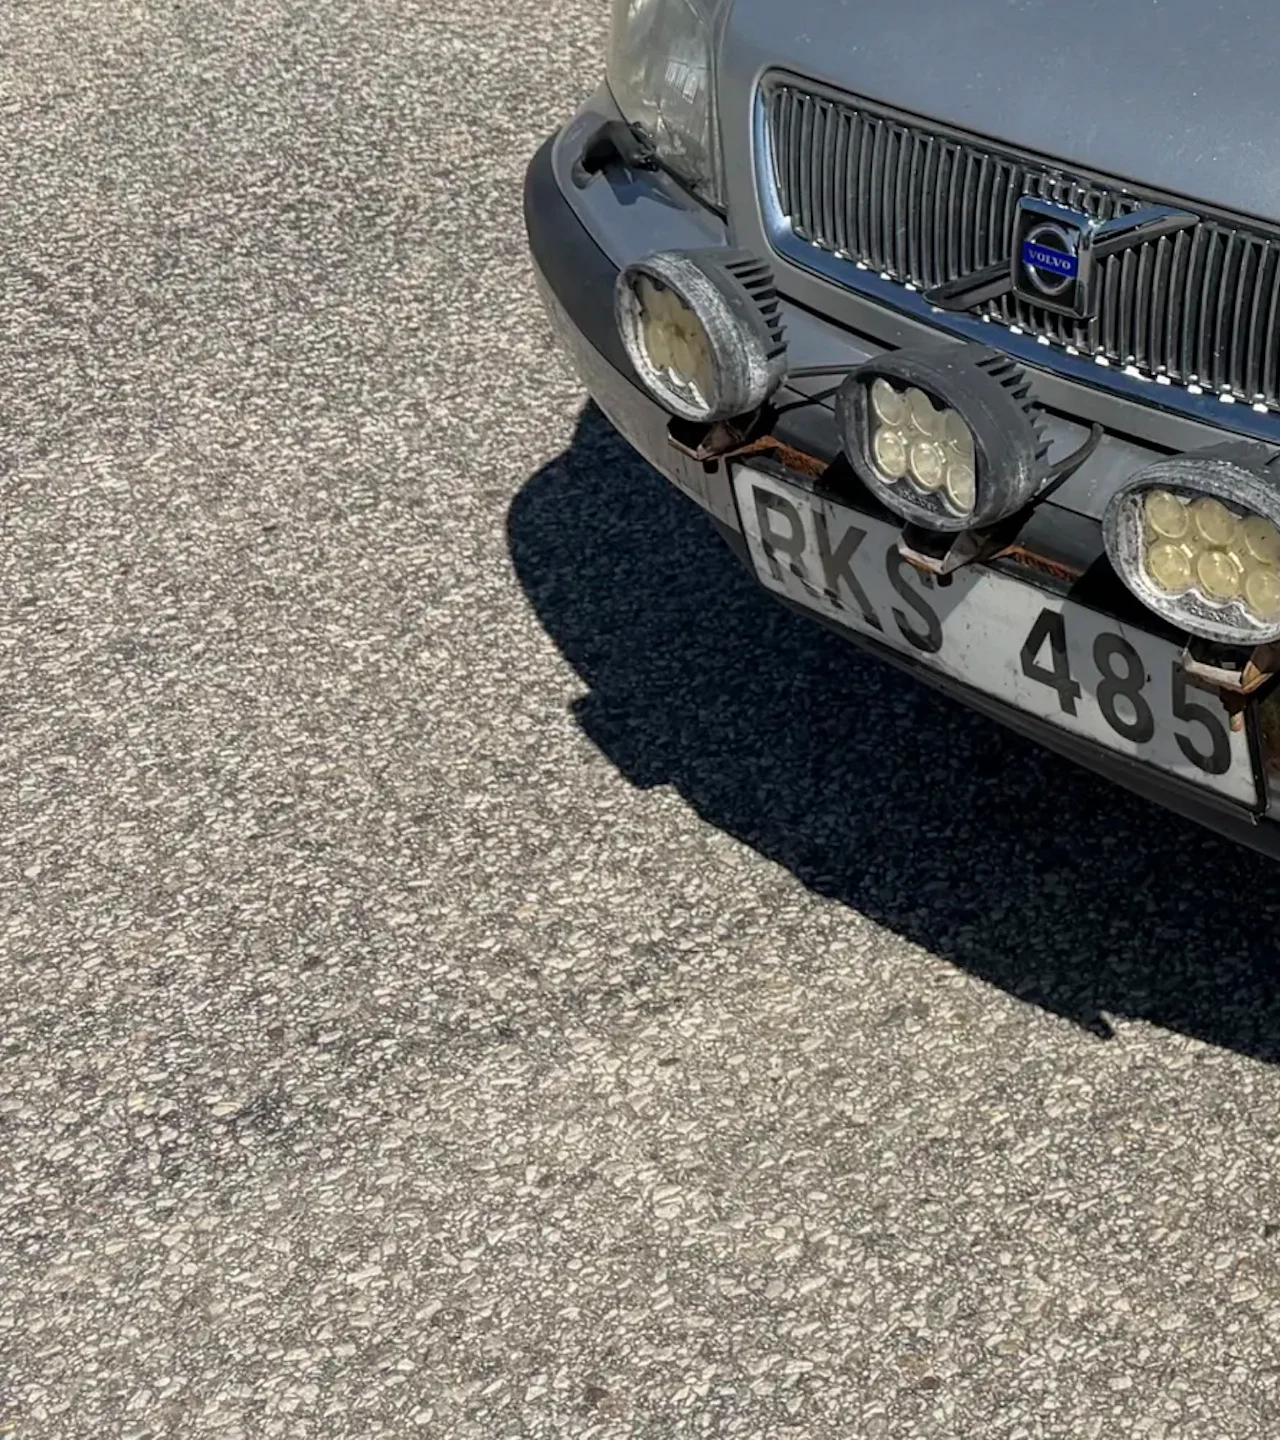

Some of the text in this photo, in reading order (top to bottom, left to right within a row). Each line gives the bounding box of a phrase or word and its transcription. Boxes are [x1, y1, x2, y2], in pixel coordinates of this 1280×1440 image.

[1027, 248, 1072, 271] VOLVO
[752, 484, 1232, 775] RKS 485
